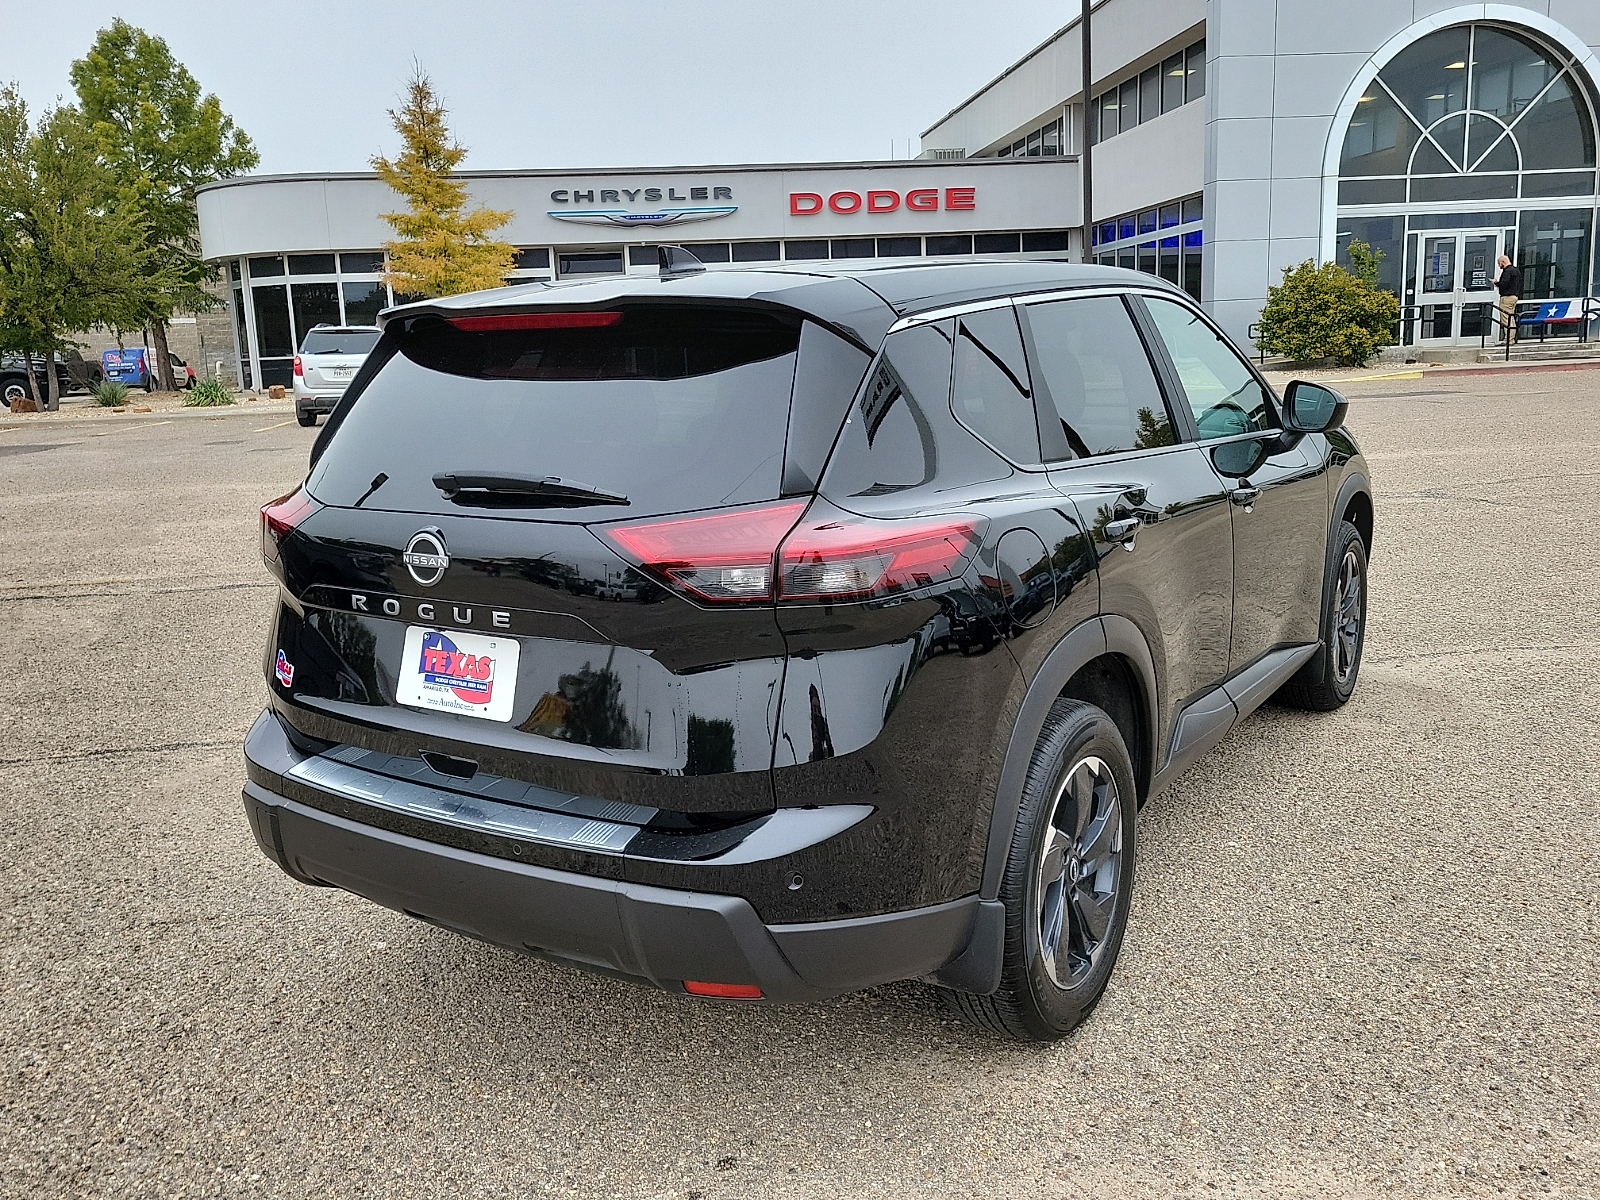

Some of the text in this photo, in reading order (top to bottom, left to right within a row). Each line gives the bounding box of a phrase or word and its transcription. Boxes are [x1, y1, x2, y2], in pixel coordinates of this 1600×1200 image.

[550, 187, 733, 203] CHRYSLER
[789, 187, 977, 215] DODGE
[403, 554, 448, 567] NISSAN
[351, 594, 512, 628] ROGUE
[424, 648, 491, 679] TEXAS
